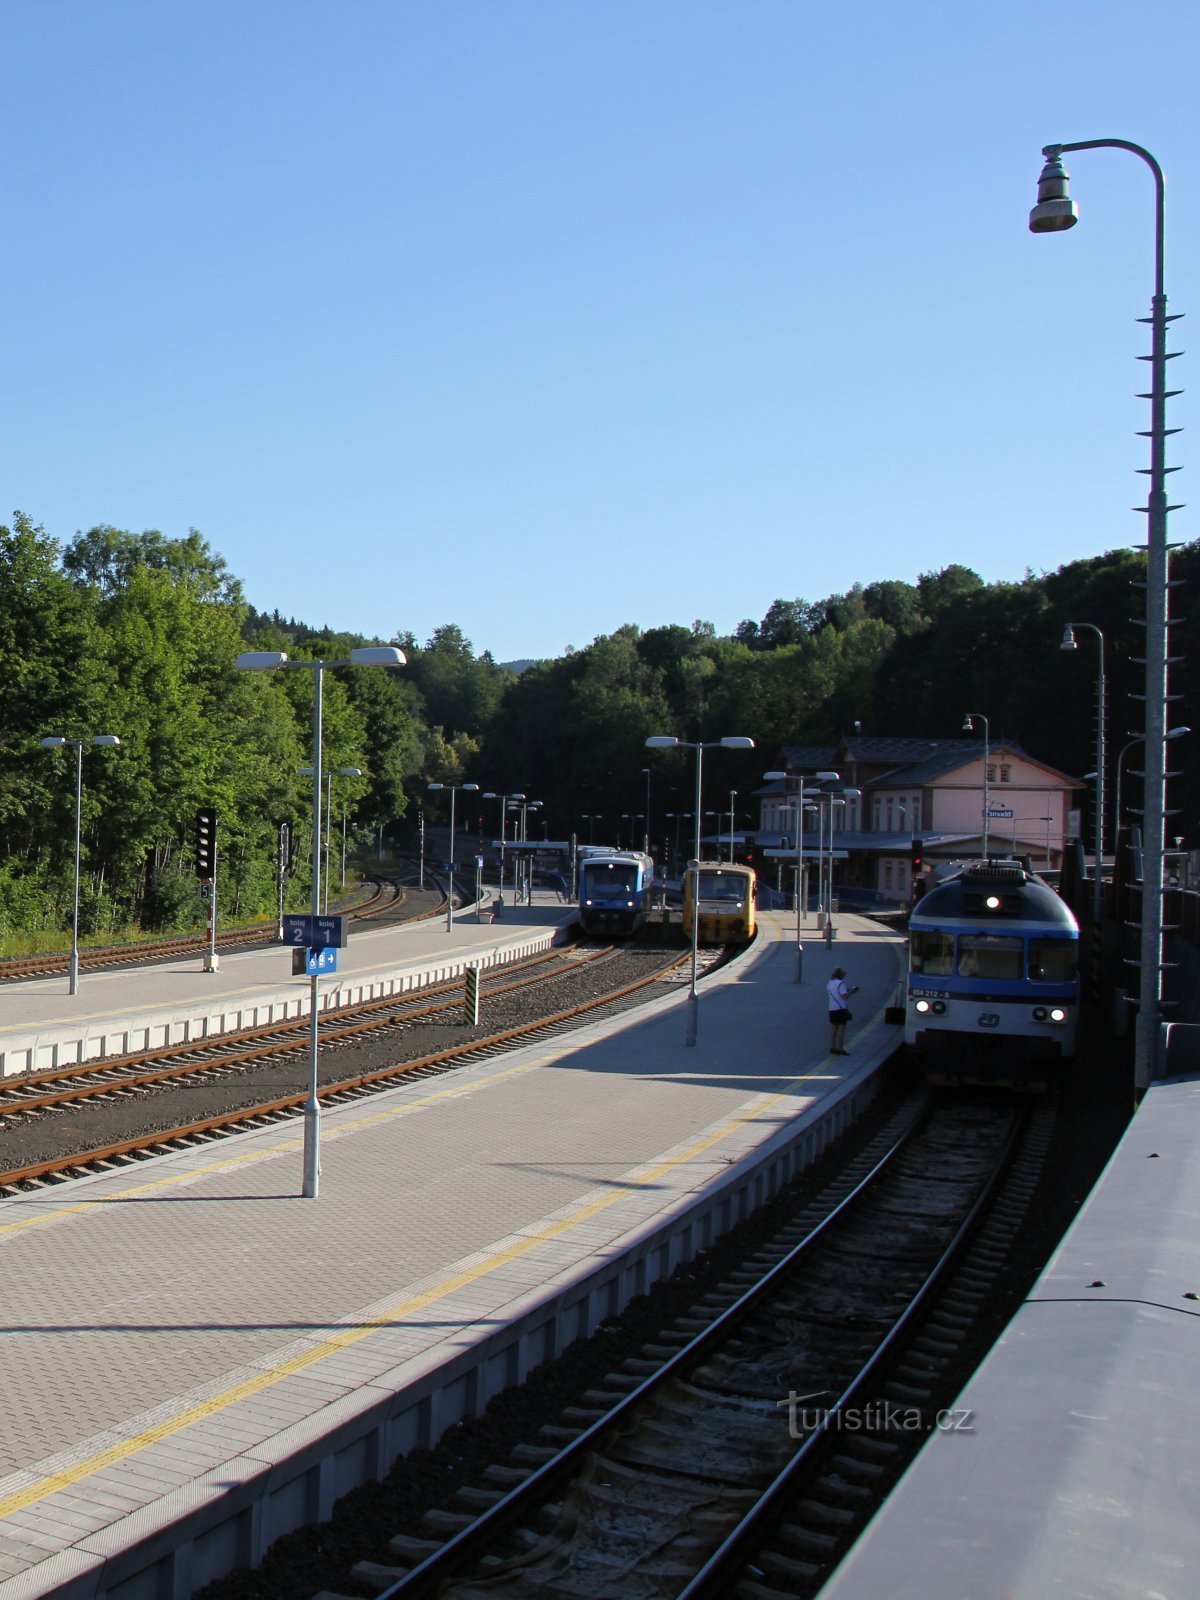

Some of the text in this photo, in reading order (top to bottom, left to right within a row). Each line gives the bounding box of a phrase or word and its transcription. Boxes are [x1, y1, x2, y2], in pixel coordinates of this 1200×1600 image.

[202, 885, 208, 898] 5
[290, 919, 305, 928] kolej
[319, 920, 335, 928] kolej
[294, 929, 303, 942] 2
[323, 931, 330, 943] 1
